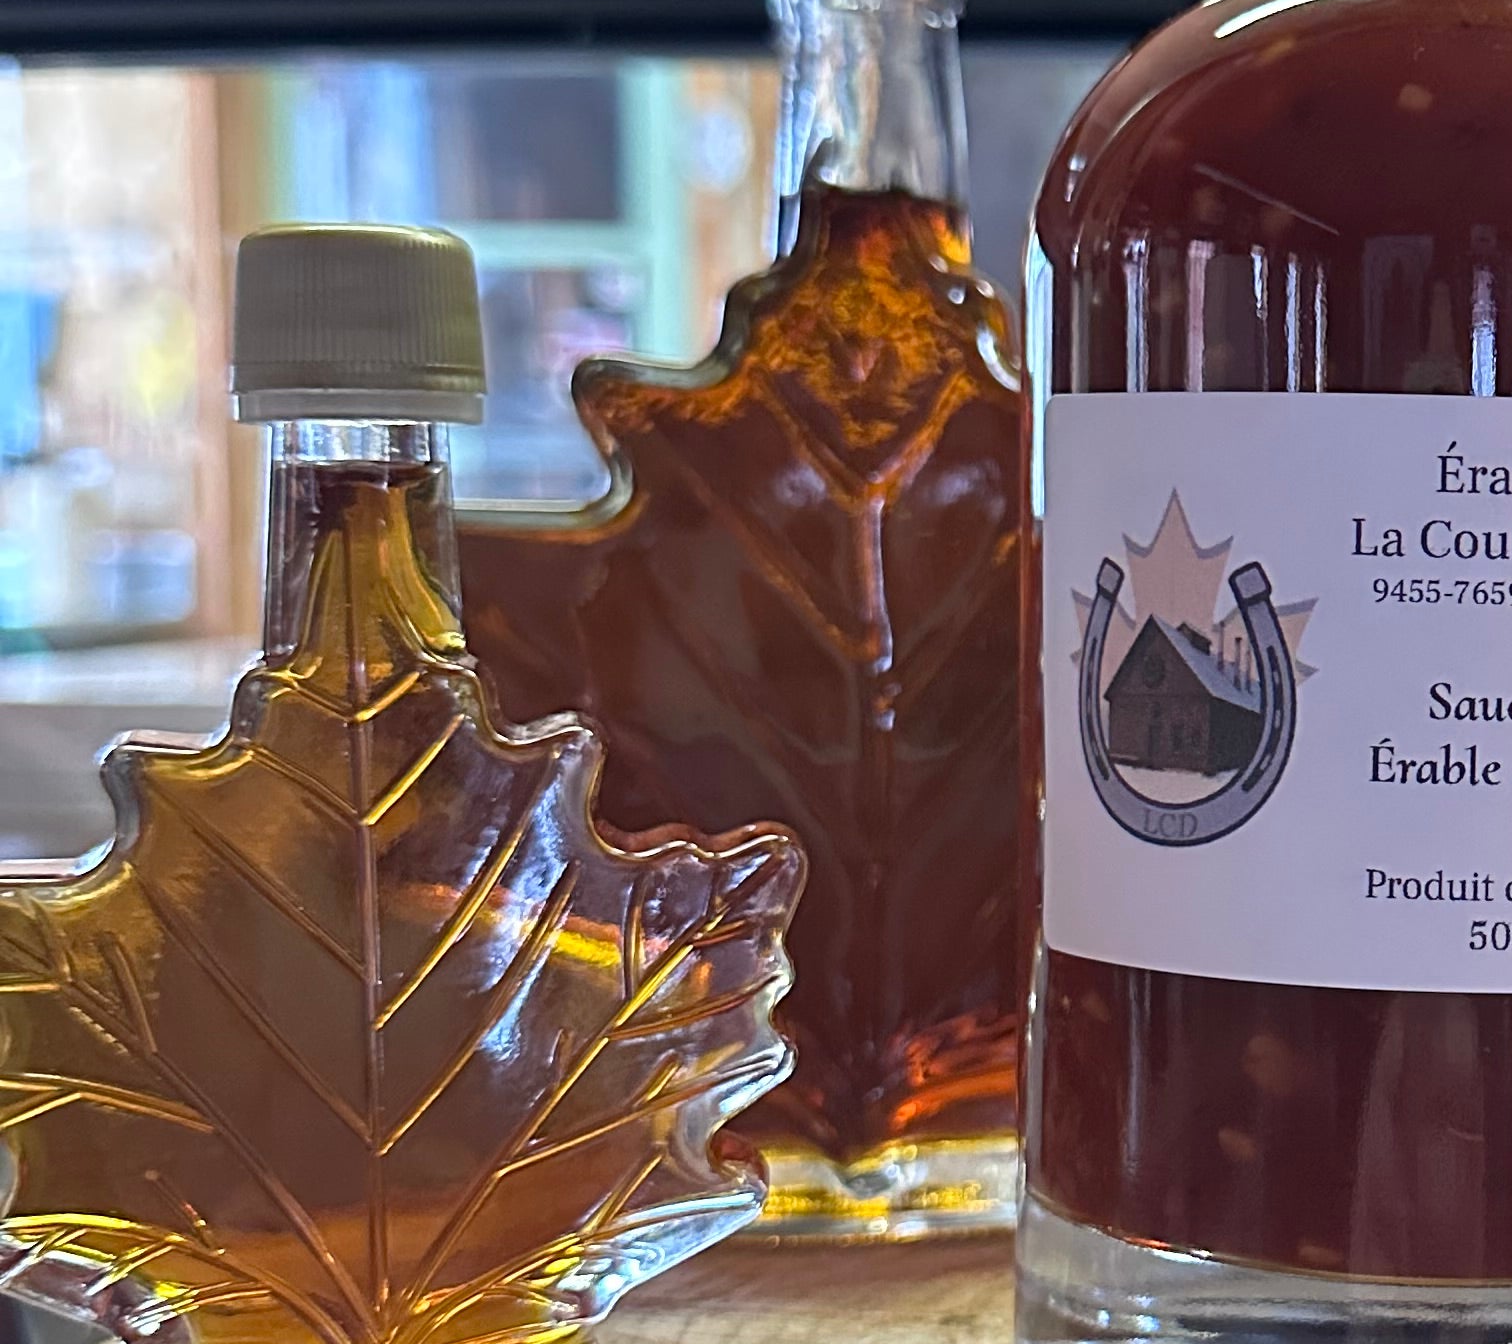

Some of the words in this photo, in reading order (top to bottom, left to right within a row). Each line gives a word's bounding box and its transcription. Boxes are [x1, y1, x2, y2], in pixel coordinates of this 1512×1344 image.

[1351, 517, 1404, 558] La
[1368, 737, 1502, 787] Érable
[1142, 809, 1199, 839] LCD
[1364, 868, 1495, 902] Produit
